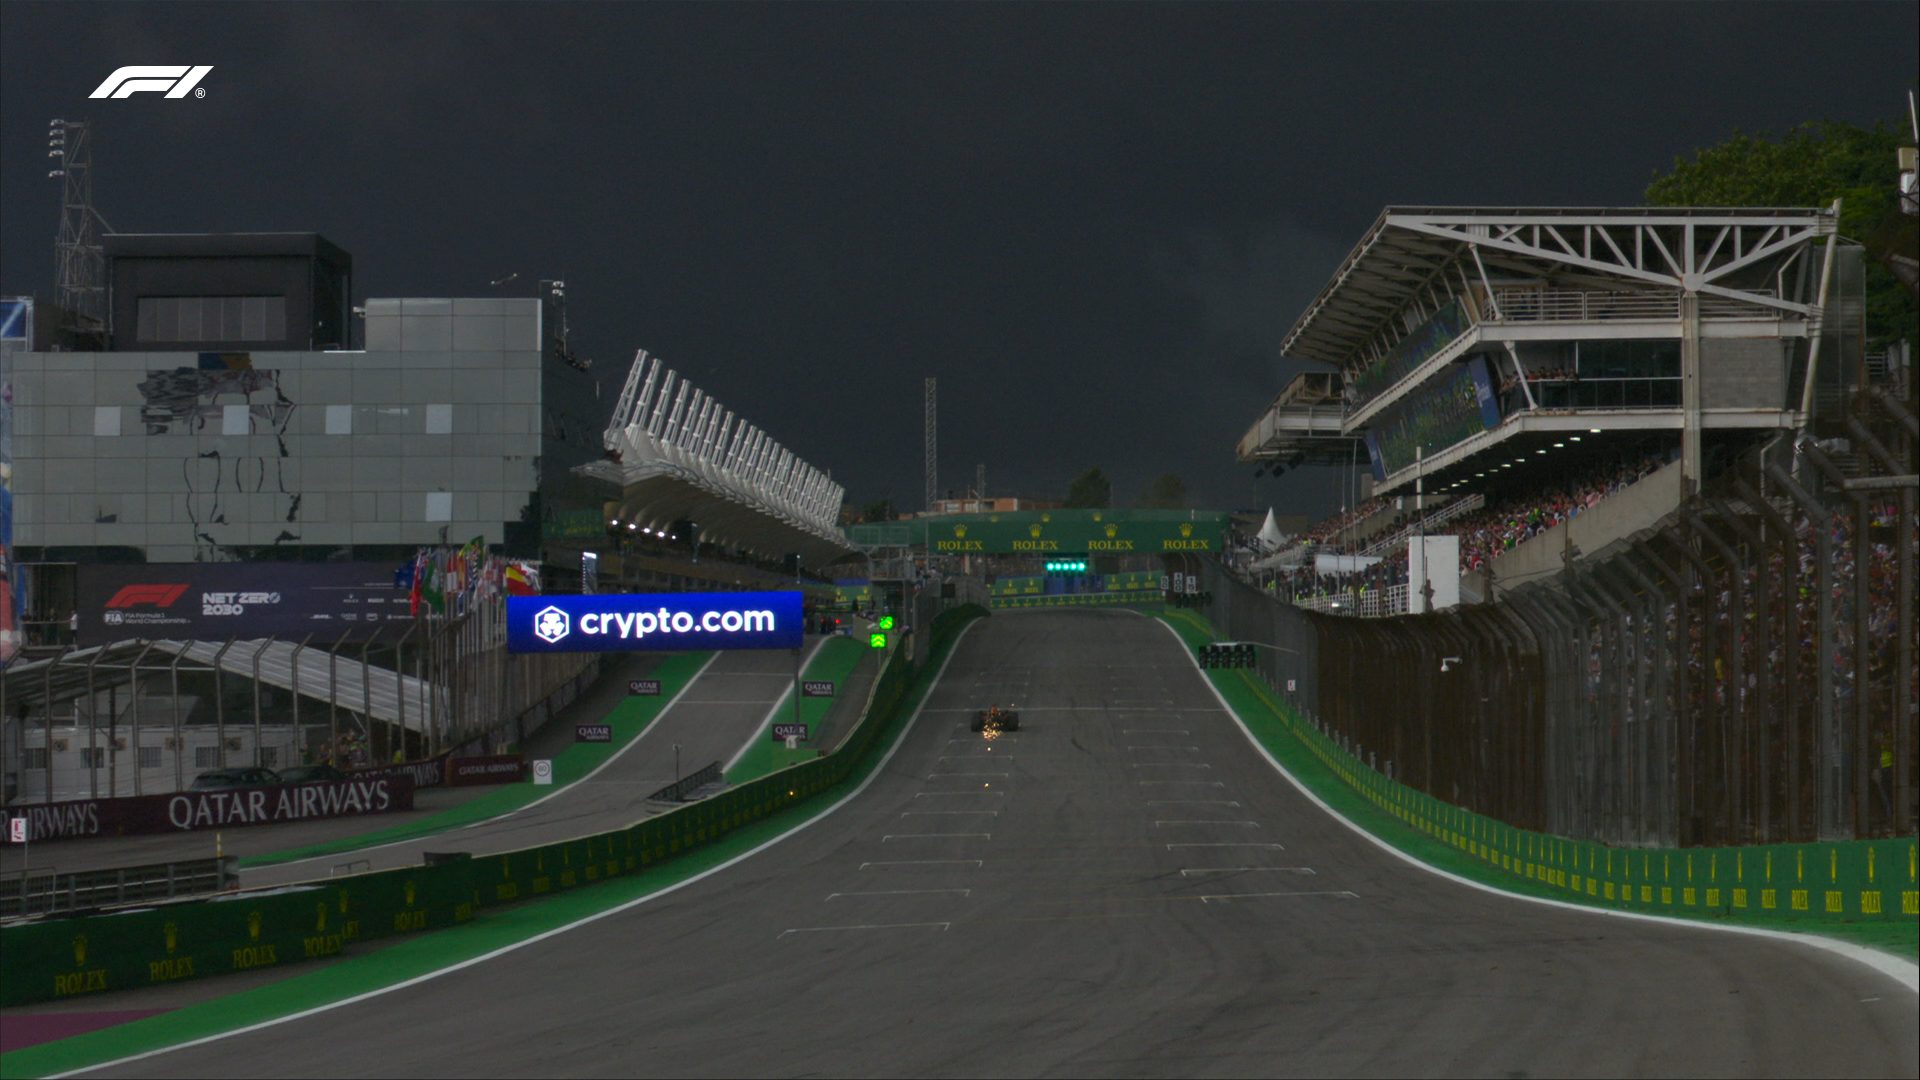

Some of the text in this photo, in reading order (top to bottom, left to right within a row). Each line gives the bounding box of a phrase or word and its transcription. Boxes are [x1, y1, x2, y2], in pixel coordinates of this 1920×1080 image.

[937, 540, 983, 550] ROLEX
[1013, 540, 1058, 550] ROLEX
[1088, 540, 1133, 550] ROLEX
[1163, 539, 1209, 549] ROLEX
[203, 592, 280, 604] NET ZERO
[203, 605, 244, 616] 2030
[104, 613, 122, 623] FIA
[580, 607, 775, 639] crypto.com
[630, 682, 658, 690] QATAR
[805, 683, 832, 691] QATAR
[579, 727, 609, 736] QATAR
[775, 726, 805, 735] QATR
[168, 780, 390, 830] QATAR AIRWAYS
[232, 944, 276, 970] ROLEX
[150, 956, 195, 981] ROLEX
[55, 969, 107, 996] ROLEX
